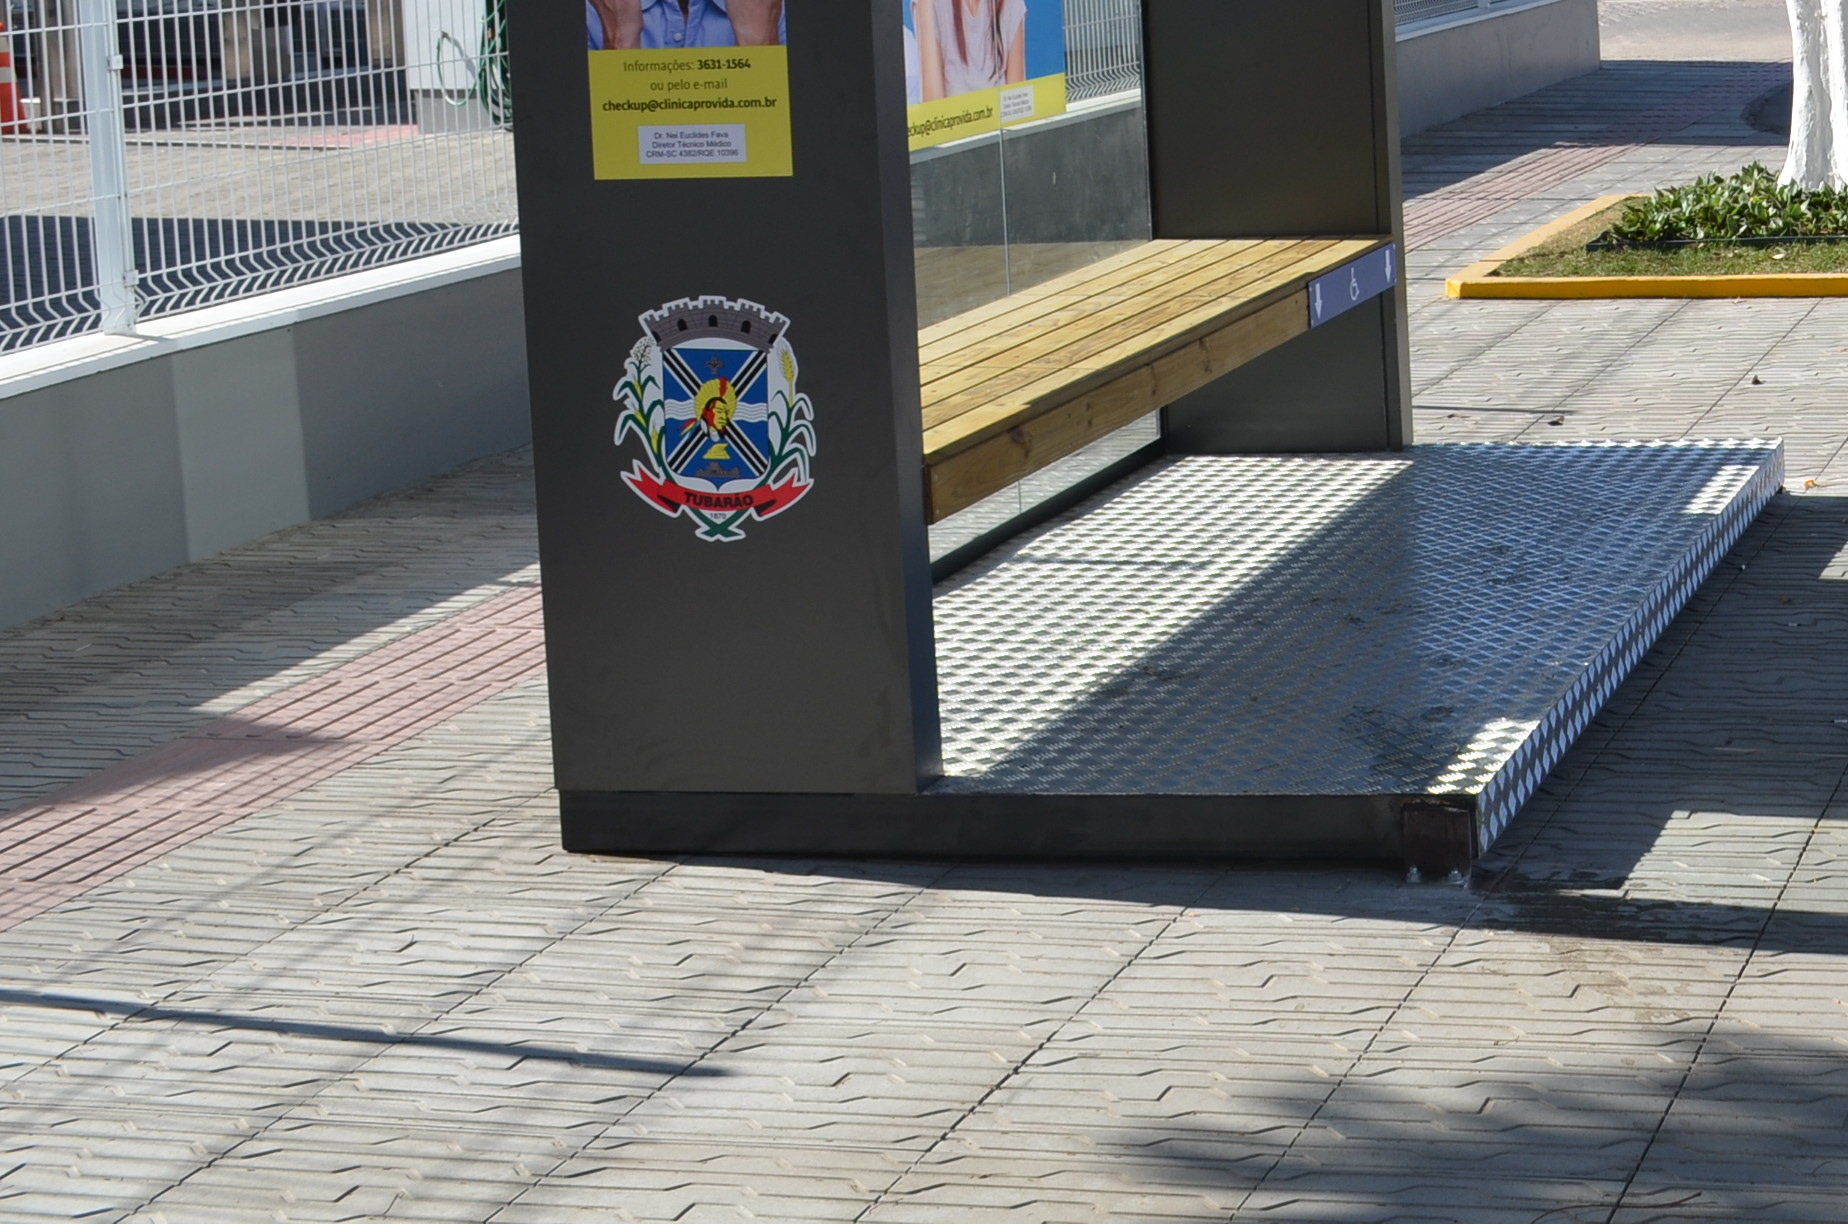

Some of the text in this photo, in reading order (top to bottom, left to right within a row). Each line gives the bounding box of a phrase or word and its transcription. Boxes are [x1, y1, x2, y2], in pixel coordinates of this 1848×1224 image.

[623, 58, 752, 74] Informações: 3631-1564
[650, 77, 728, 93] ou pelo e-mail
[602, 96, 777, 113] checkup@clinicaprovida.com.br
[653, 130, 729, 139] Dr. Nei Euclides Fava
[652, 139, 732, 149] Diretor Técnico Médico
[646, 149, 677, 158] CRM-SC
[684, 490, 754, 509] TUBARÃO
